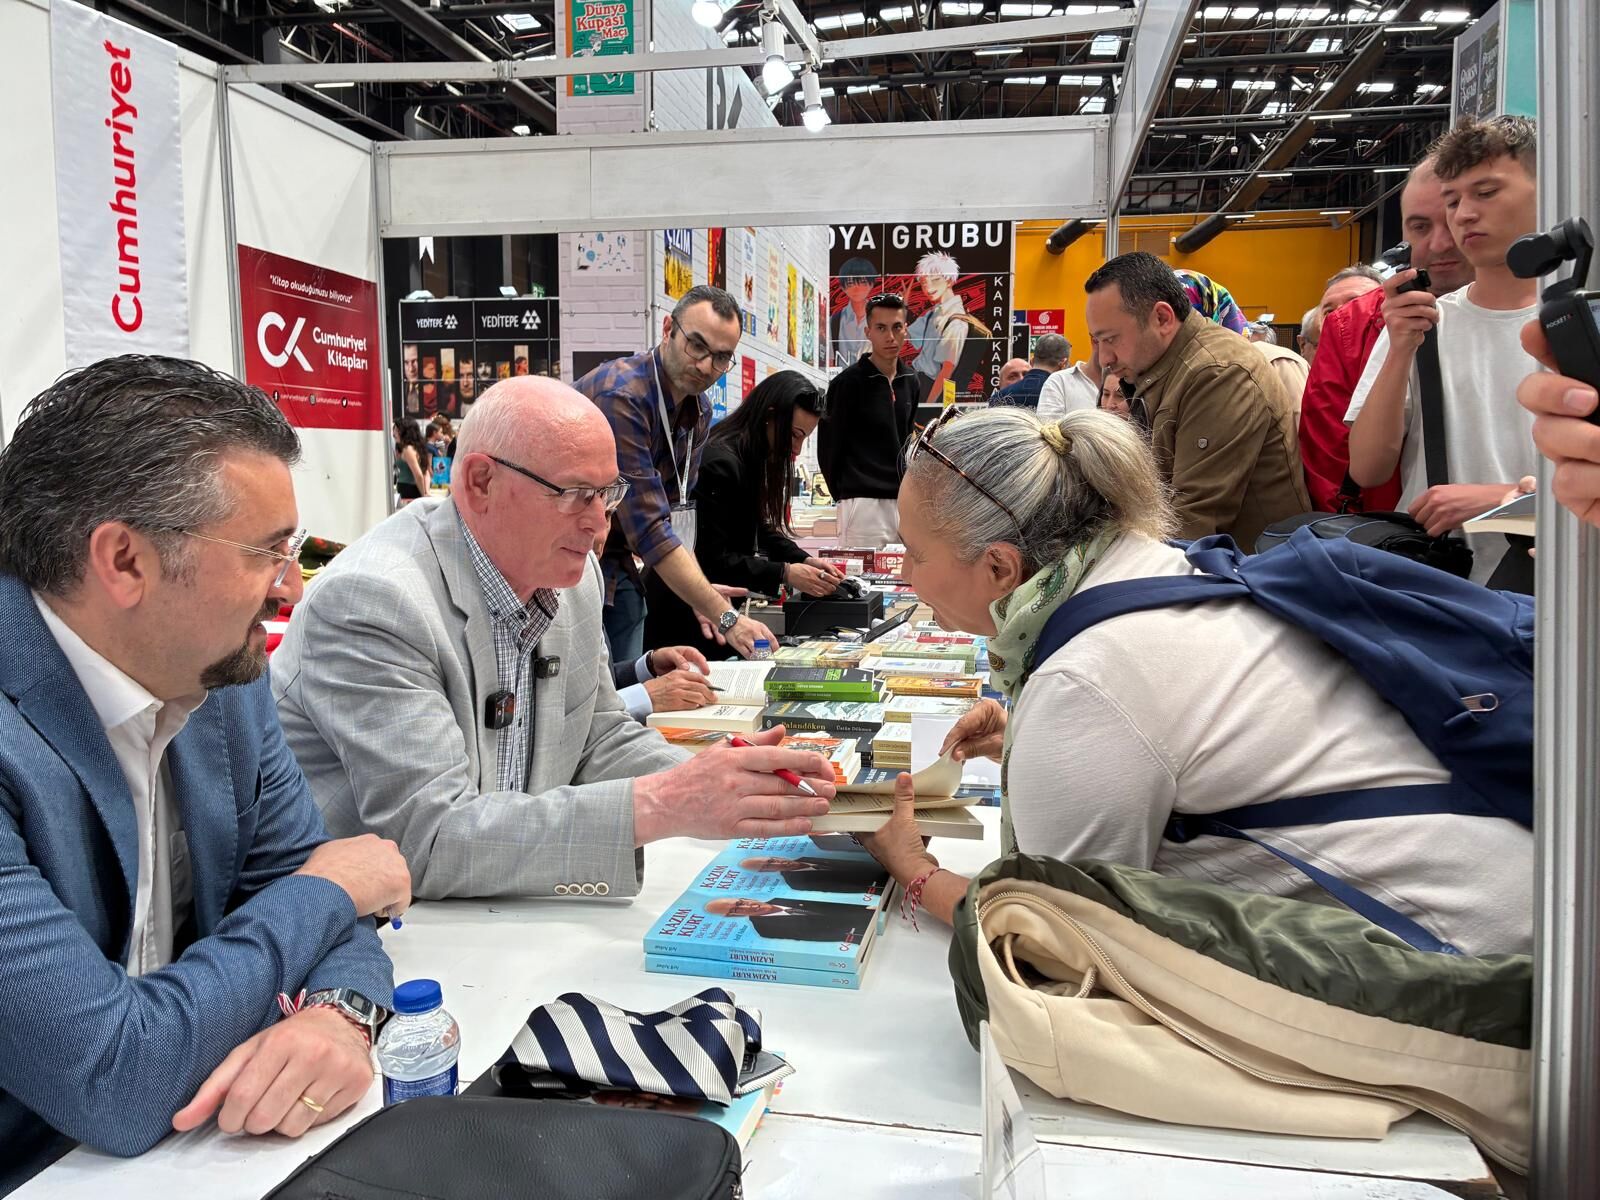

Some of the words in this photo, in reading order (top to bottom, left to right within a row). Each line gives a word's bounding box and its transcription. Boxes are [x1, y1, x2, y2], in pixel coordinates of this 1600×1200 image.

[585, 3, 626, 17] Dünya
[576, 16, 624, 32] Kupası
[602, 28, 628, 39] Maçı
[103, 40, 143, 333] Cumhuriyet
[892, 222, 1003, 249] GRUBU
[992, 276, 1003, 332] KARA
[416, 317, 443, 328] YEDİTEPE
[481, 313, 519, 328] YEDİTEPE
[313, 327, 367, 351] Cumhuriyet
[328, 350, 368, 372] Kitapları
[781, 721, 826, 731] Palandöken
[700, 865, 729, 889] KAZIM
[717, 870, 741, 890] KURT
[659, 908, 692, 936] KAZIM
[677, 914, 705, 937] KURT
[729, 953, 749, 962] KURT
[749, 955, 774, 964] KAZIM
[731, 971, 751, 980] KURT
[752, 973, 777, 981] KAZIM
